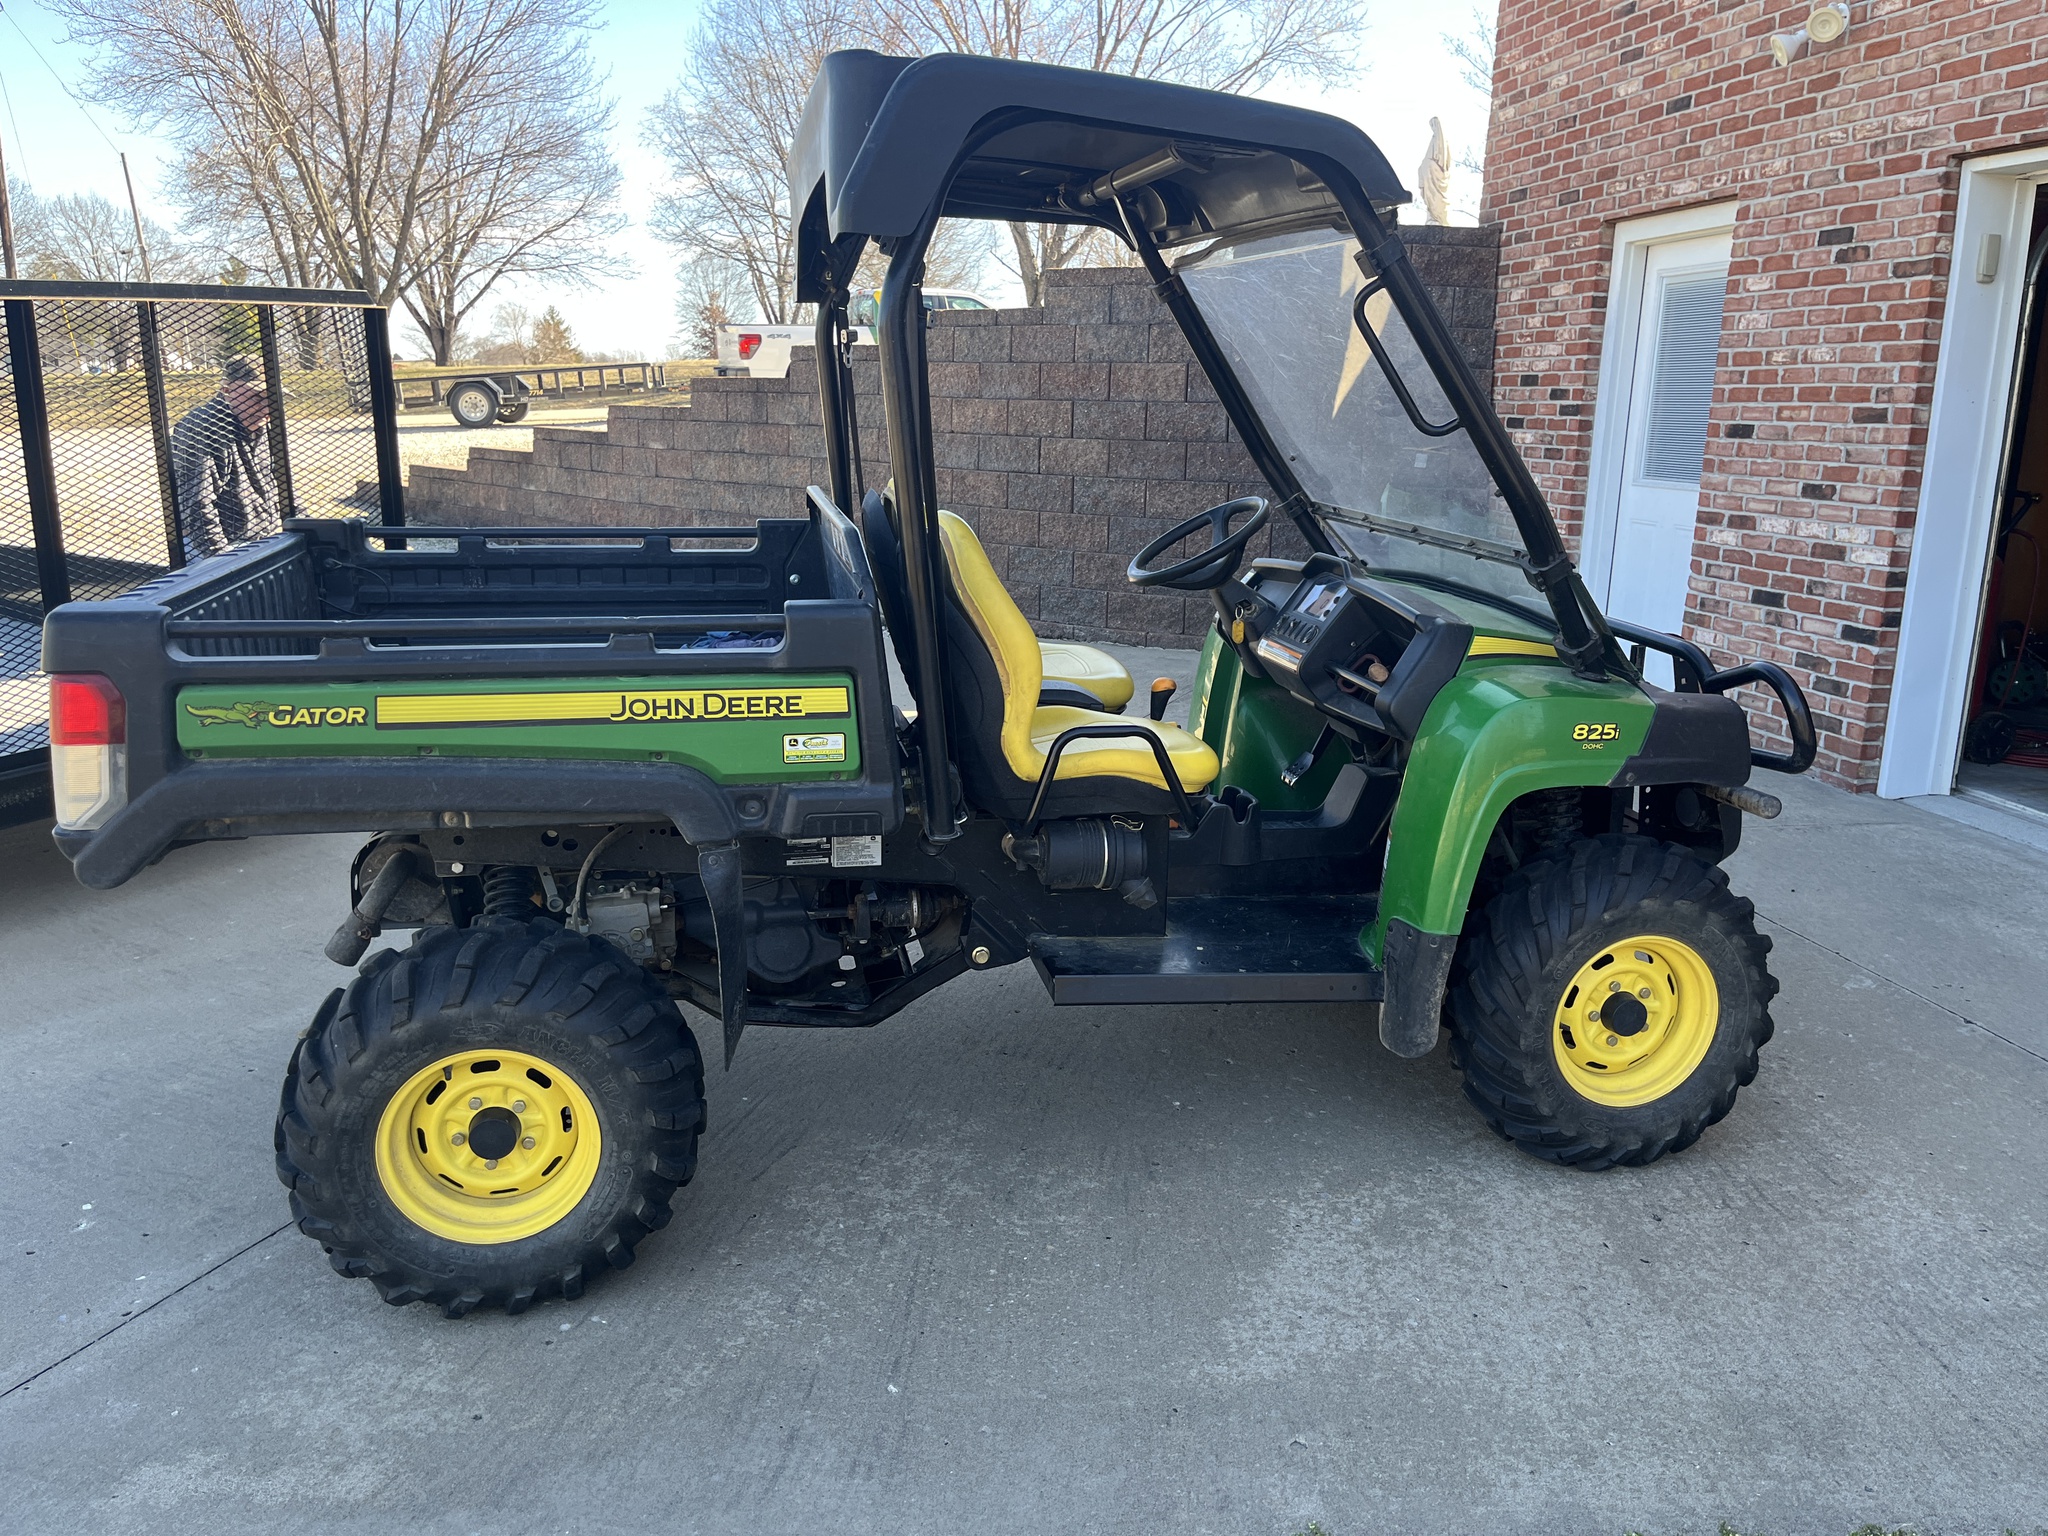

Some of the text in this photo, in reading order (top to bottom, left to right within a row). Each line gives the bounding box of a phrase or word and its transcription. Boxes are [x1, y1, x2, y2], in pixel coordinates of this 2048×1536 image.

[609, 692, 803, 718] JOHN DEERE
[267, 705, 367, 726] GATOR
[1571, 723, 1621, 741] 825i
[1581, 742, 1605, 751] DOHC
